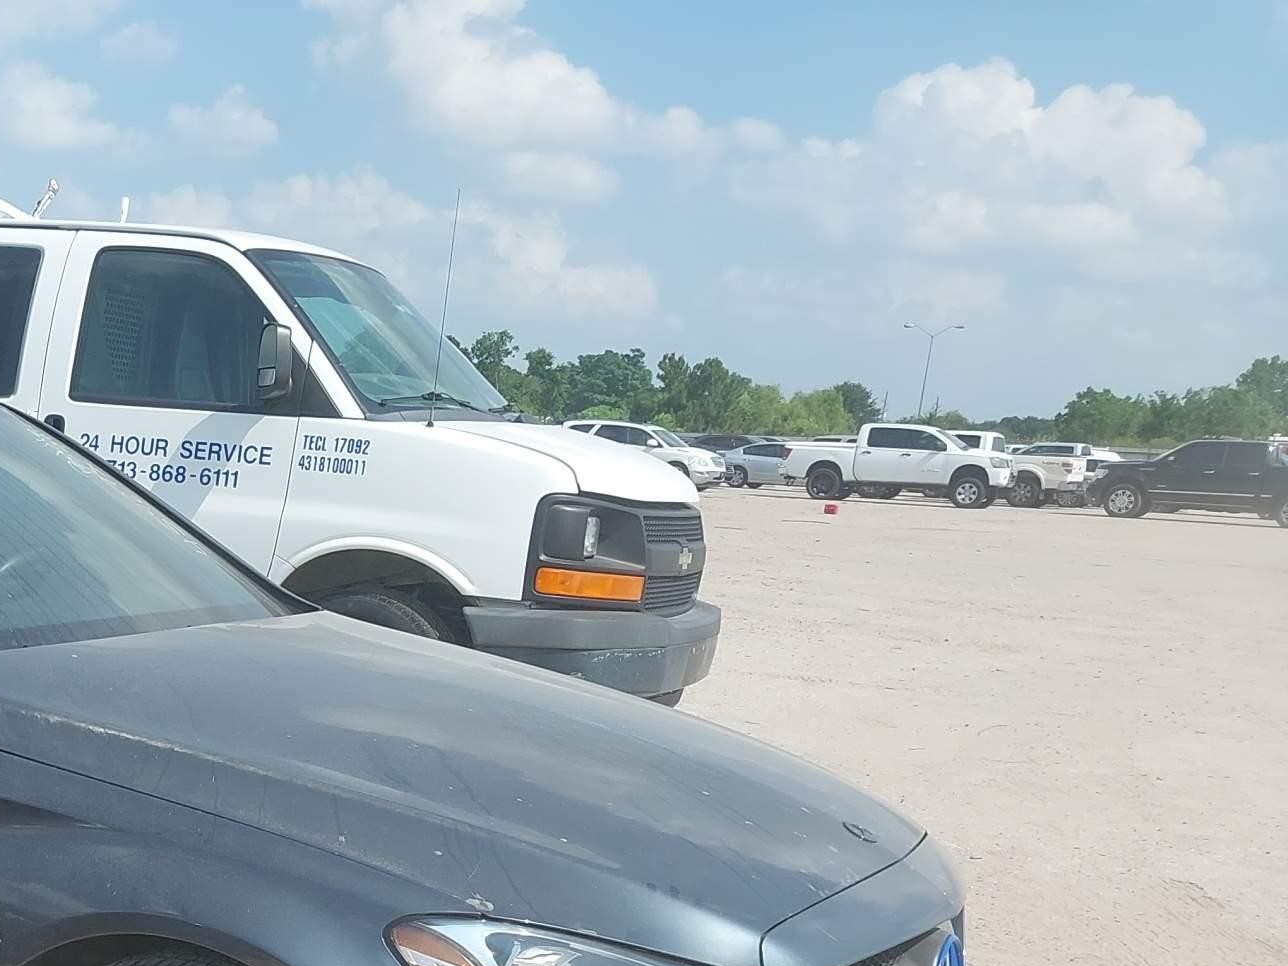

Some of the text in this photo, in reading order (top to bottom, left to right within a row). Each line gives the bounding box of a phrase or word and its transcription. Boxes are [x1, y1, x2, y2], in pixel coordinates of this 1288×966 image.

[80, 433, 100, 451] 24
[110, 434, 169, 457] HOUR
[180, 440, 273, 465] SERVICE
[303, 435, 371, 455] TECL 17092
[298, 455, 366, 476] 4318100011
